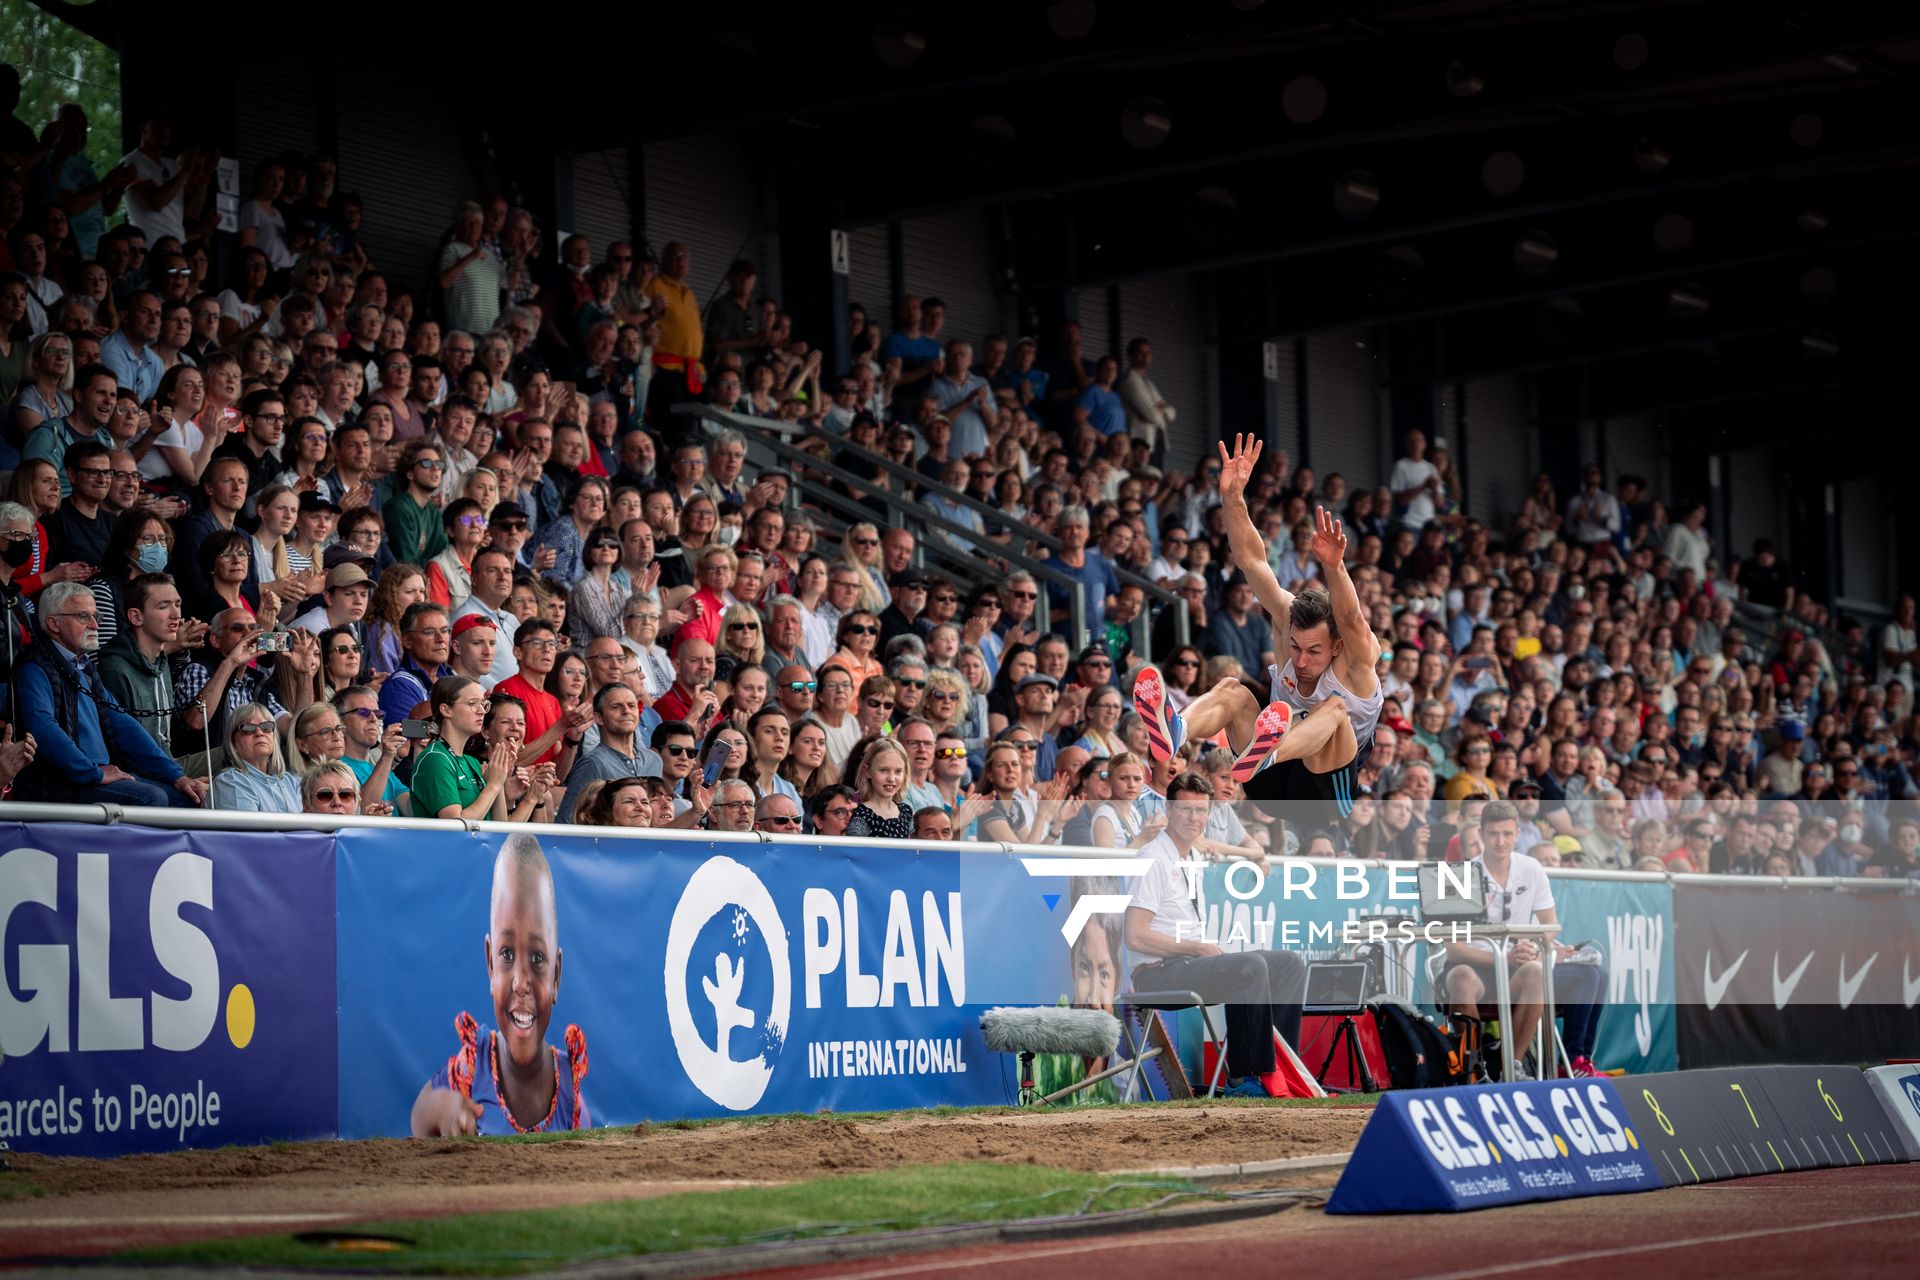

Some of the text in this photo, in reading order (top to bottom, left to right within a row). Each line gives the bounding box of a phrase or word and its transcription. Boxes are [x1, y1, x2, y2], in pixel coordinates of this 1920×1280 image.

[803, 887, 966, 1009] PLAN
[809, 1038, 967, 1079] INTERNATIONAL
[92, 1088, 121, 1132] to
[130, 1079, 220, 1142] People
[1642, 1089, 1674, 1136] 8
[1730, 1084, 1760, 1128] 7
[1817, 1078, 1843, 1122] 6
